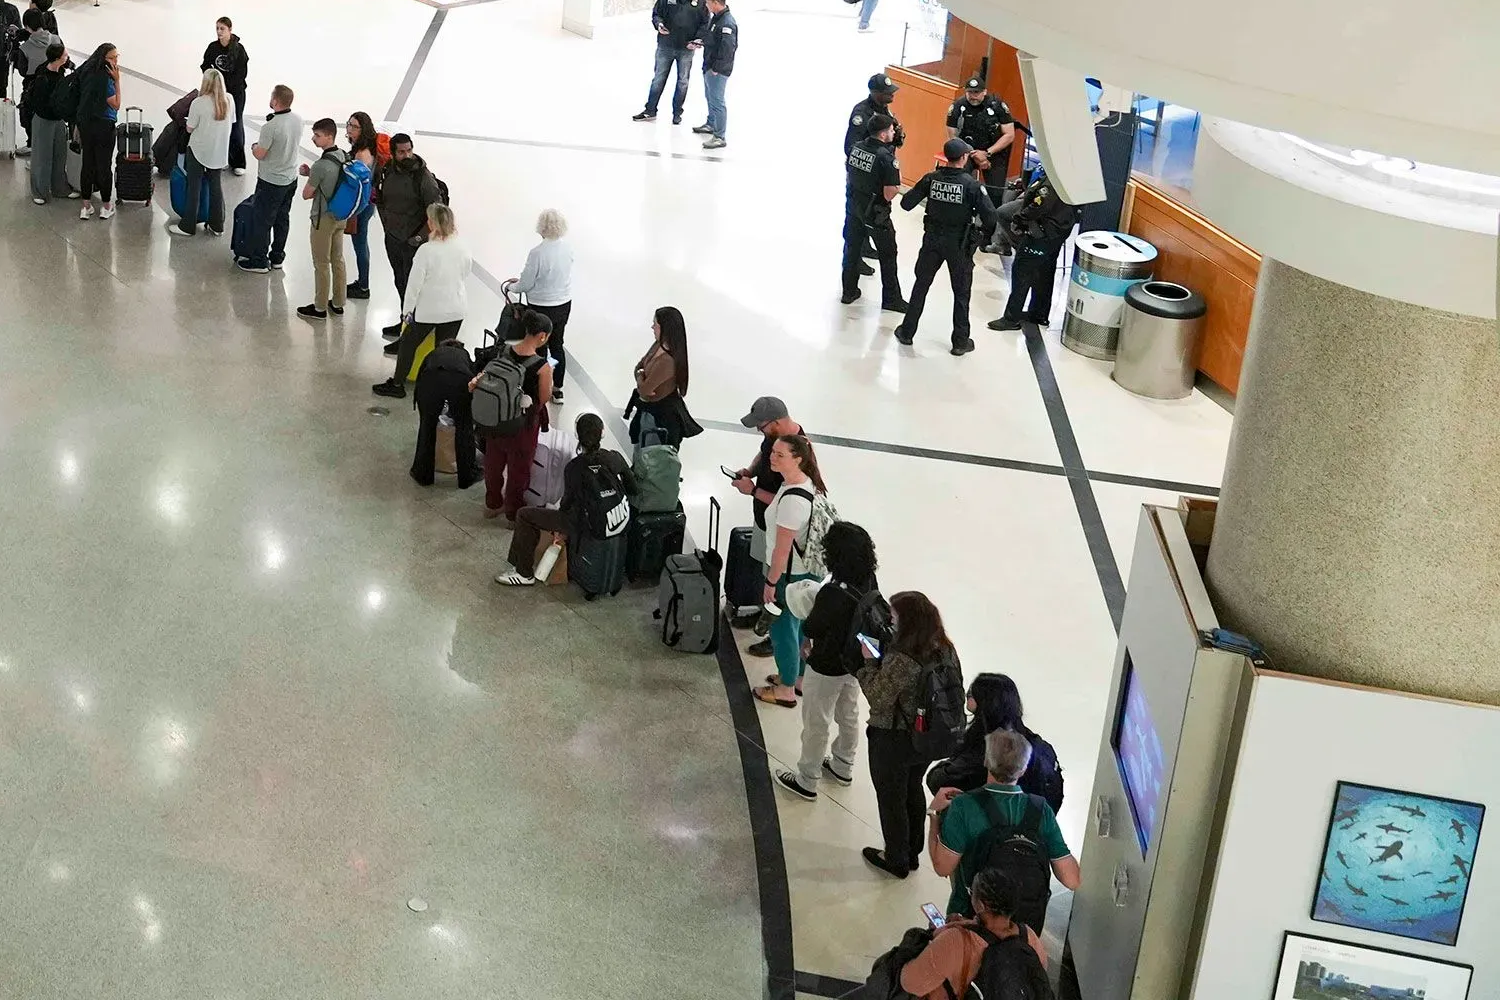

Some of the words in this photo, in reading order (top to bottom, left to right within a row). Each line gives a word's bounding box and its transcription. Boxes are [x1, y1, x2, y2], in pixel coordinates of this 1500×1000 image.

[852, 148, 874, 161] ATLANTA
[849, 156, 872, 173] POLICE
[931, 181, 961, 194] ATLANTA
[930, 190, 961, 203] POLICE
[606, 495, 629, 530] NIK
